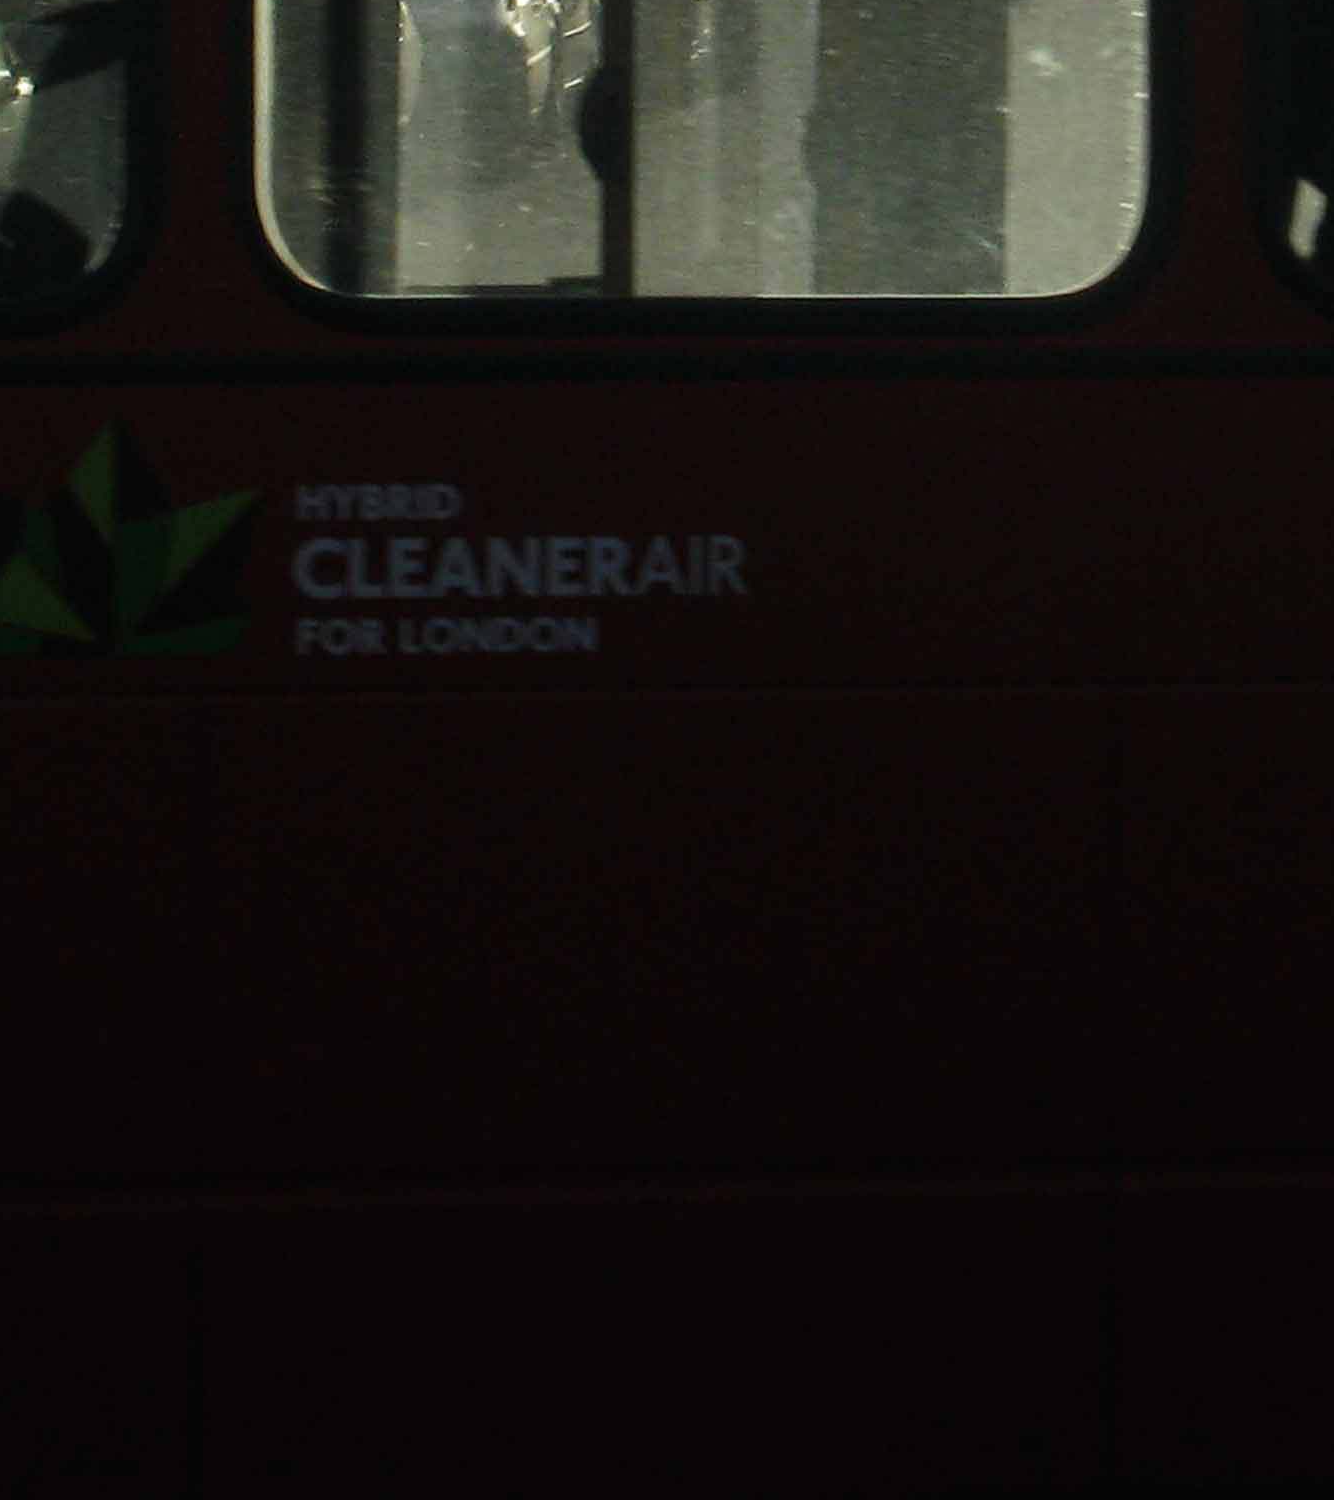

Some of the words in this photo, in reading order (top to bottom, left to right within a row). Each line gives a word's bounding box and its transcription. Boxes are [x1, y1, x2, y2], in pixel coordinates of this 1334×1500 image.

[294, 483, 464, 524] HYBRID
[294, 616, 387, 657] FOR
[395, 615, 600, 655] LONDON
